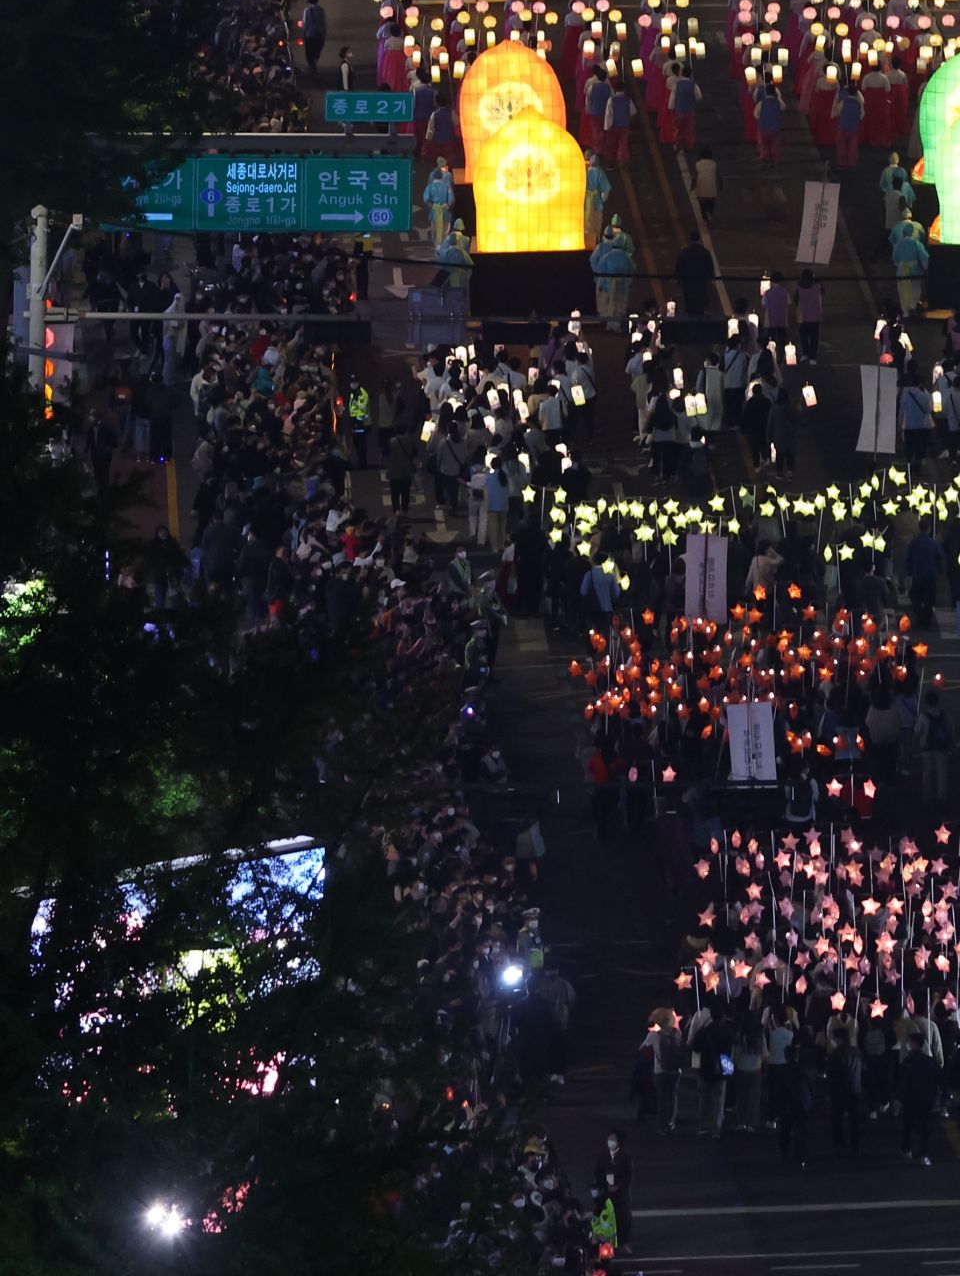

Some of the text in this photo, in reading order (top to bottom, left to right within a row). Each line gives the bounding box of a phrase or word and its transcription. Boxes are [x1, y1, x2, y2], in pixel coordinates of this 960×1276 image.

[332, 99, 407, 115] 종로2가
[226, 162, 297, 181] 세종대로사거리
[318, 170, 398, 191] 안국역
[226, 182, 297, 195] Sejong-daero Jct
[207, 191, 215, 202] 6
[319, 193, 398, 207] Anguk Stn
[225, 196, 297, 213] 종로1가
[373, 211, 389, 222] 50
